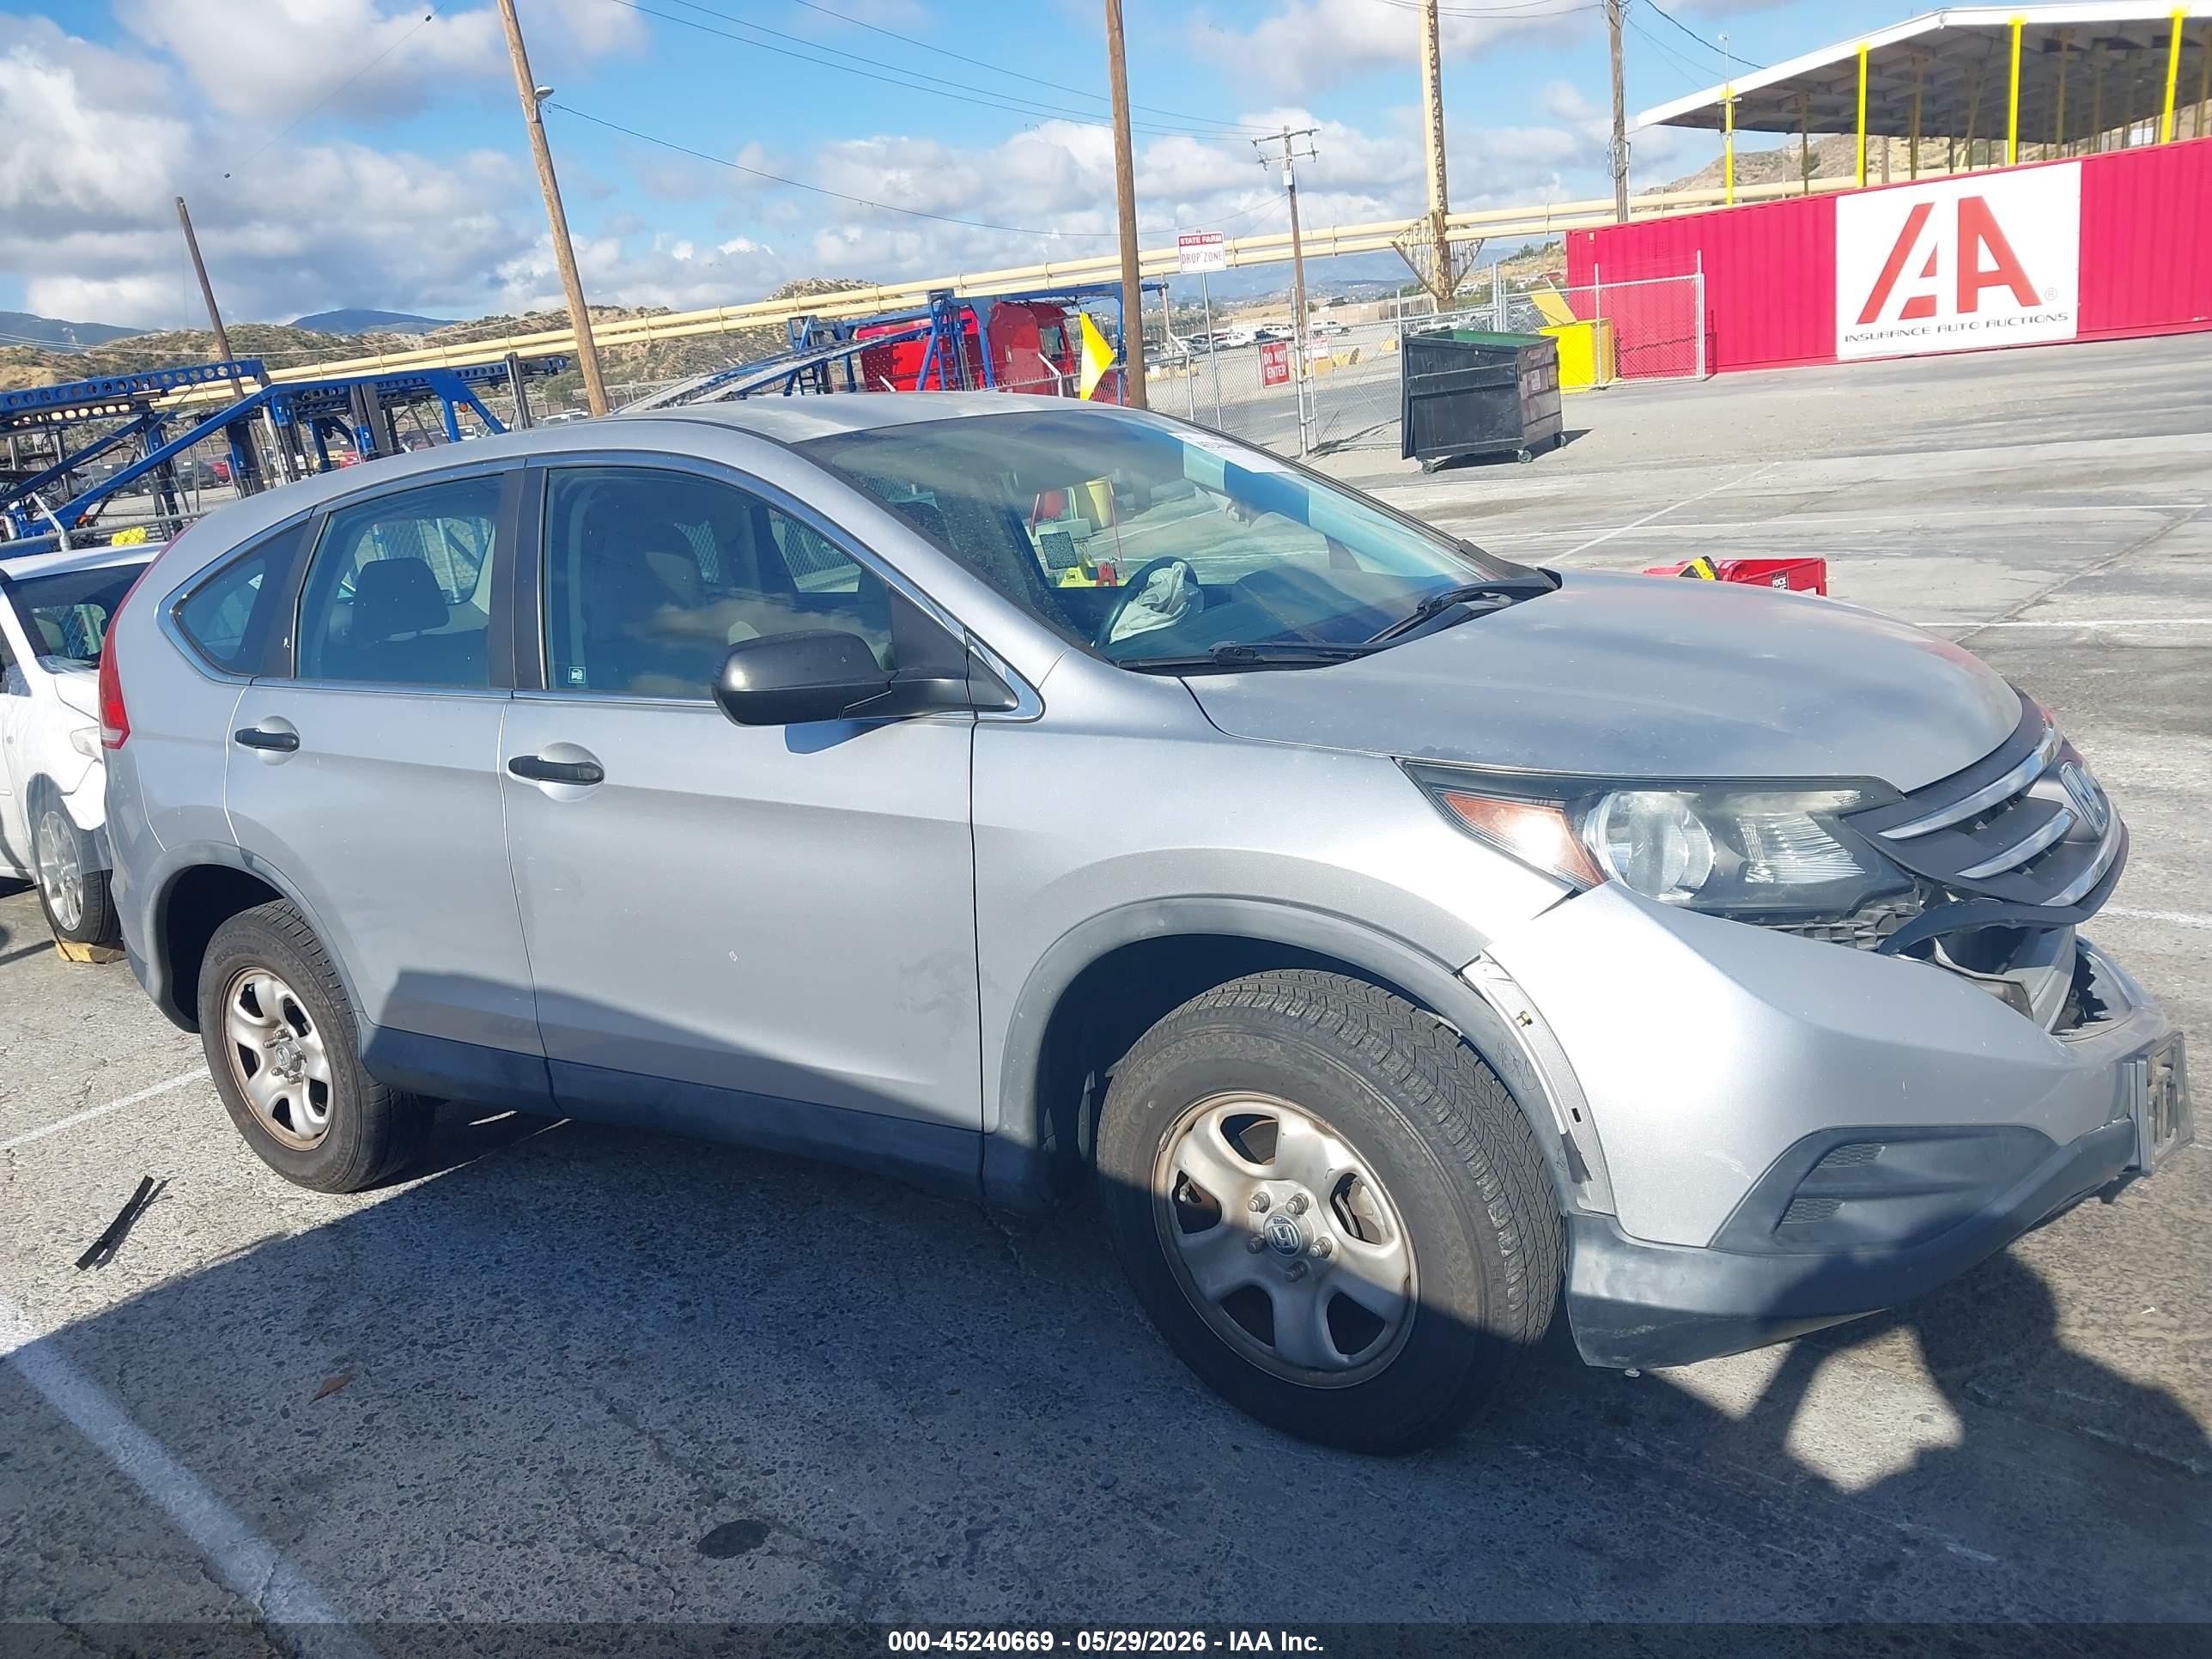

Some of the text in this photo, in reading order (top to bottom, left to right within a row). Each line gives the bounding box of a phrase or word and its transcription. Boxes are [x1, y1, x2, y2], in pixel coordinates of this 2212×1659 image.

[1180, 234, 1222, 246] STATE FARM
[1182, 251, 1223, 264] DROP ZONE
[1844, 312, 2069, 343] INSURANCE AUTO AUCTIONS
[1263, 349, 1287, 365] DO NOT
[1267, 365, 1286, 379] ENTER
